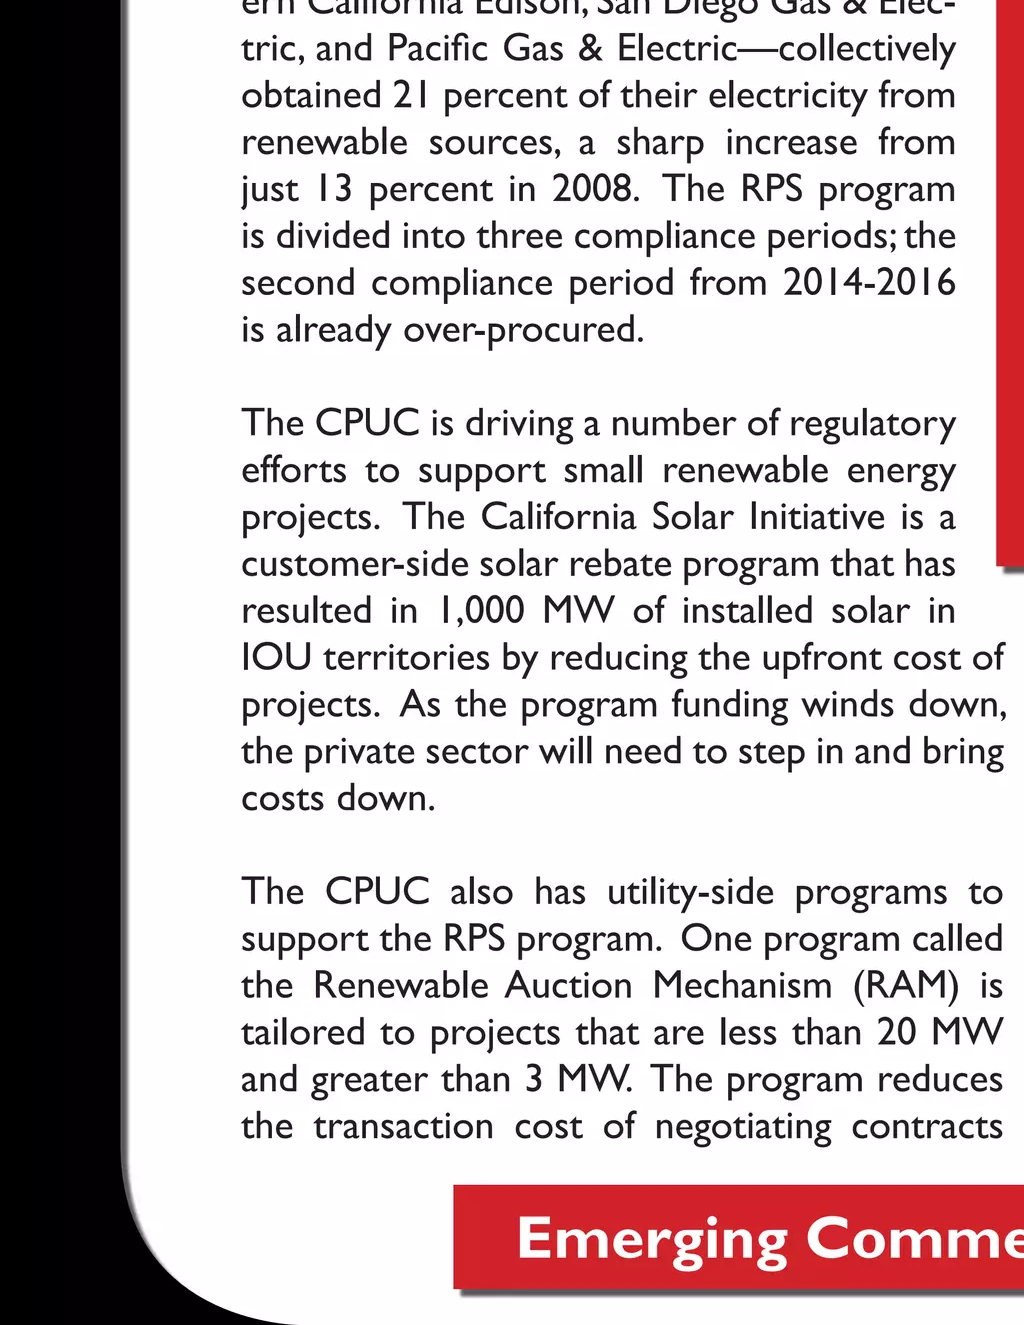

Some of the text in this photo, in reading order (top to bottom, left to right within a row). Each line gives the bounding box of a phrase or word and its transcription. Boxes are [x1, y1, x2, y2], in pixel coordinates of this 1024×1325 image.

[240, 32, 957, 71] tric, and Pacific Gas & Electric—collectively
[240, 172, 955, 211] just 13 percent in 2008. The RPS program
[241, 407, 957, 445] The CPUC is driving a number of regulatory
[242, 500, 957, 539] projects. The California Solar Initiative is a
[242, 688, 1007, 727] projects. As the program funding winds down,
[241, 875, 1003, 914] The CPUC also has utility-side programs to
[240, 969, 1003, 1008] the Renewable Auction Mechanism (RAM) is
[520, 1216, 787, 1272] Emerging
